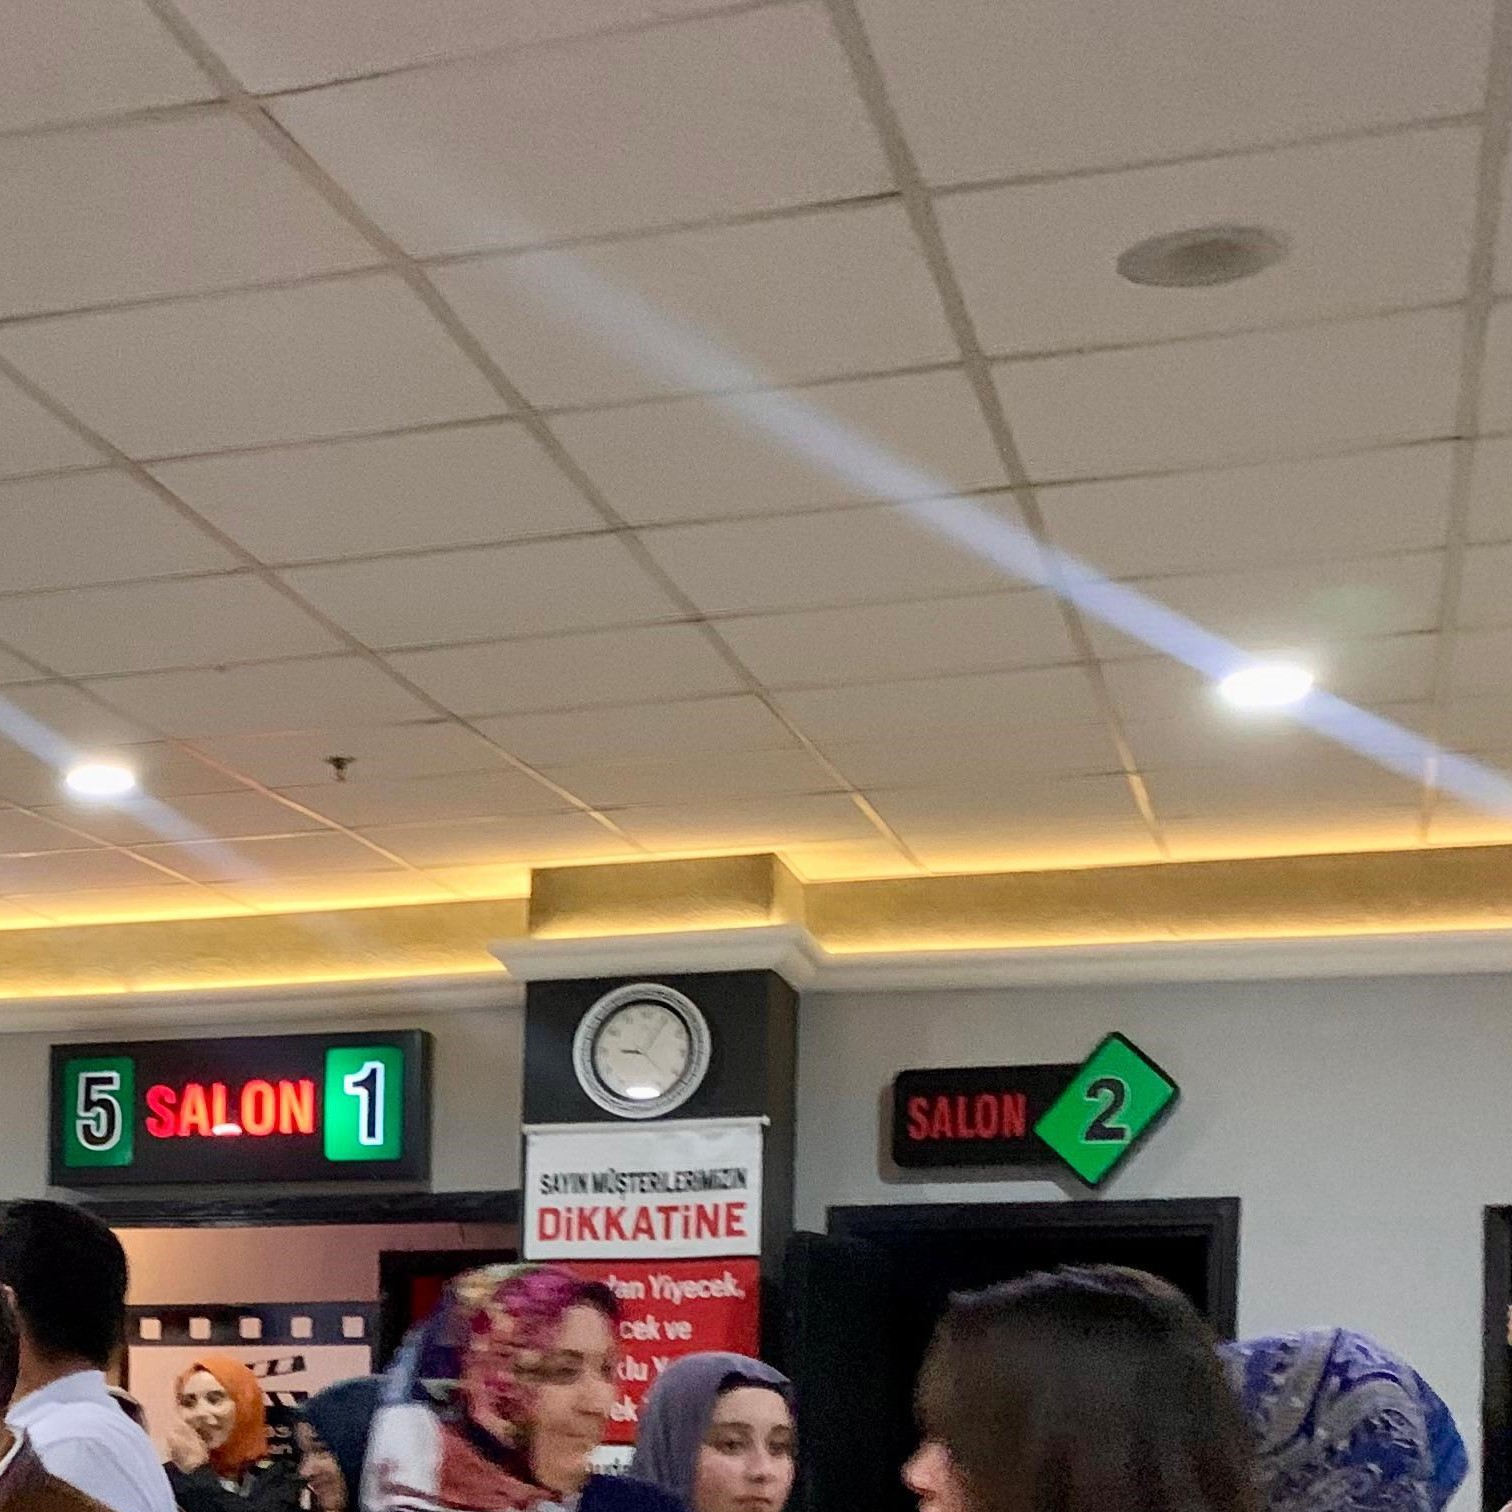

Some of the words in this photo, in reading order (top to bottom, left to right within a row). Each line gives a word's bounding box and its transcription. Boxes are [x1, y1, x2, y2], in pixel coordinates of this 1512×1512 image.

[76, 1070, 122, 1151] 5
[144, 1078, 315, 1138] SALON
[343, 1060, 385, 1146] 1
[906, 1091, 1028, 1141] SALON
[1081, 1075, 1131, 1145] 2
[663, 1320, 693, 1341] ve
